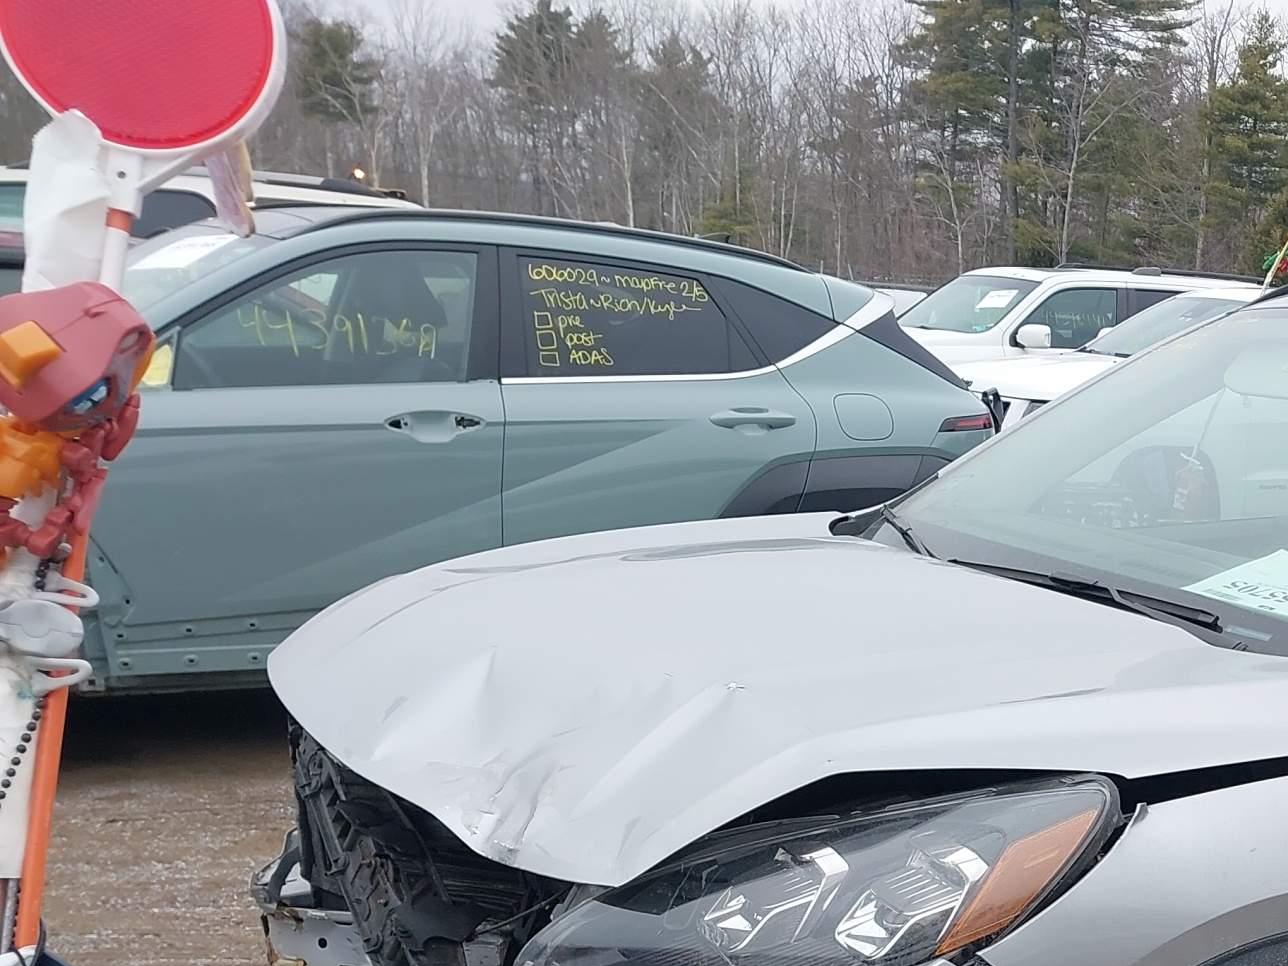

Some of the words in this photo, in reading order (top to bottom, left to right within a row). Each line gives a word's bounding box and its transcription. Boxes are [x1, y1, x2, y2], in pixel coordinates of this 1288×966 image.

[528, 264, 599, 286] 606029
[679, 281, 709, 303] 2/5
[558, 314, 585, 338] pre
[565, 333, 603, 349] post
[569, 348, 615, 366] ADAS
